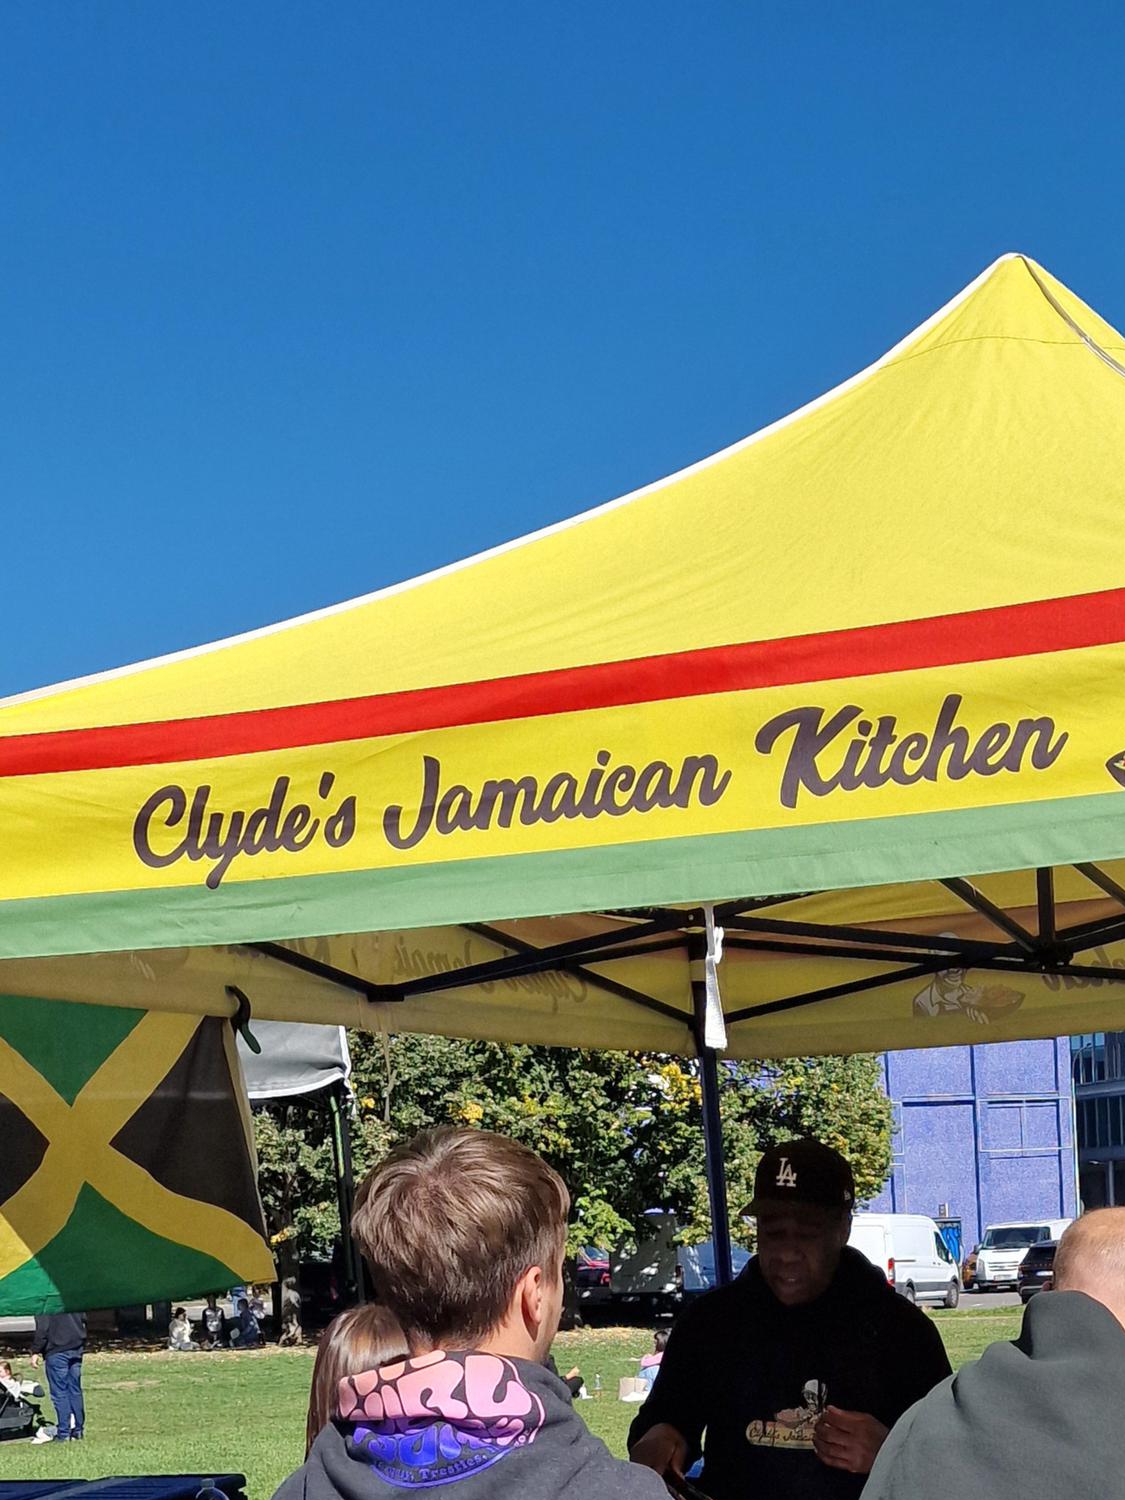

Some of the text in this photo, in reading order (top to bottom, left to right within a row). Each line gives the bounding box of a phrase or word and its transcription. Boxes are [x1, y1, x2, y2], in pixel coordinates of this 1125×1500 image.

[133, 693, 1069, 889] Clyde's Jamaican Kitchen
[776, 1156, 798, 1188] LA
